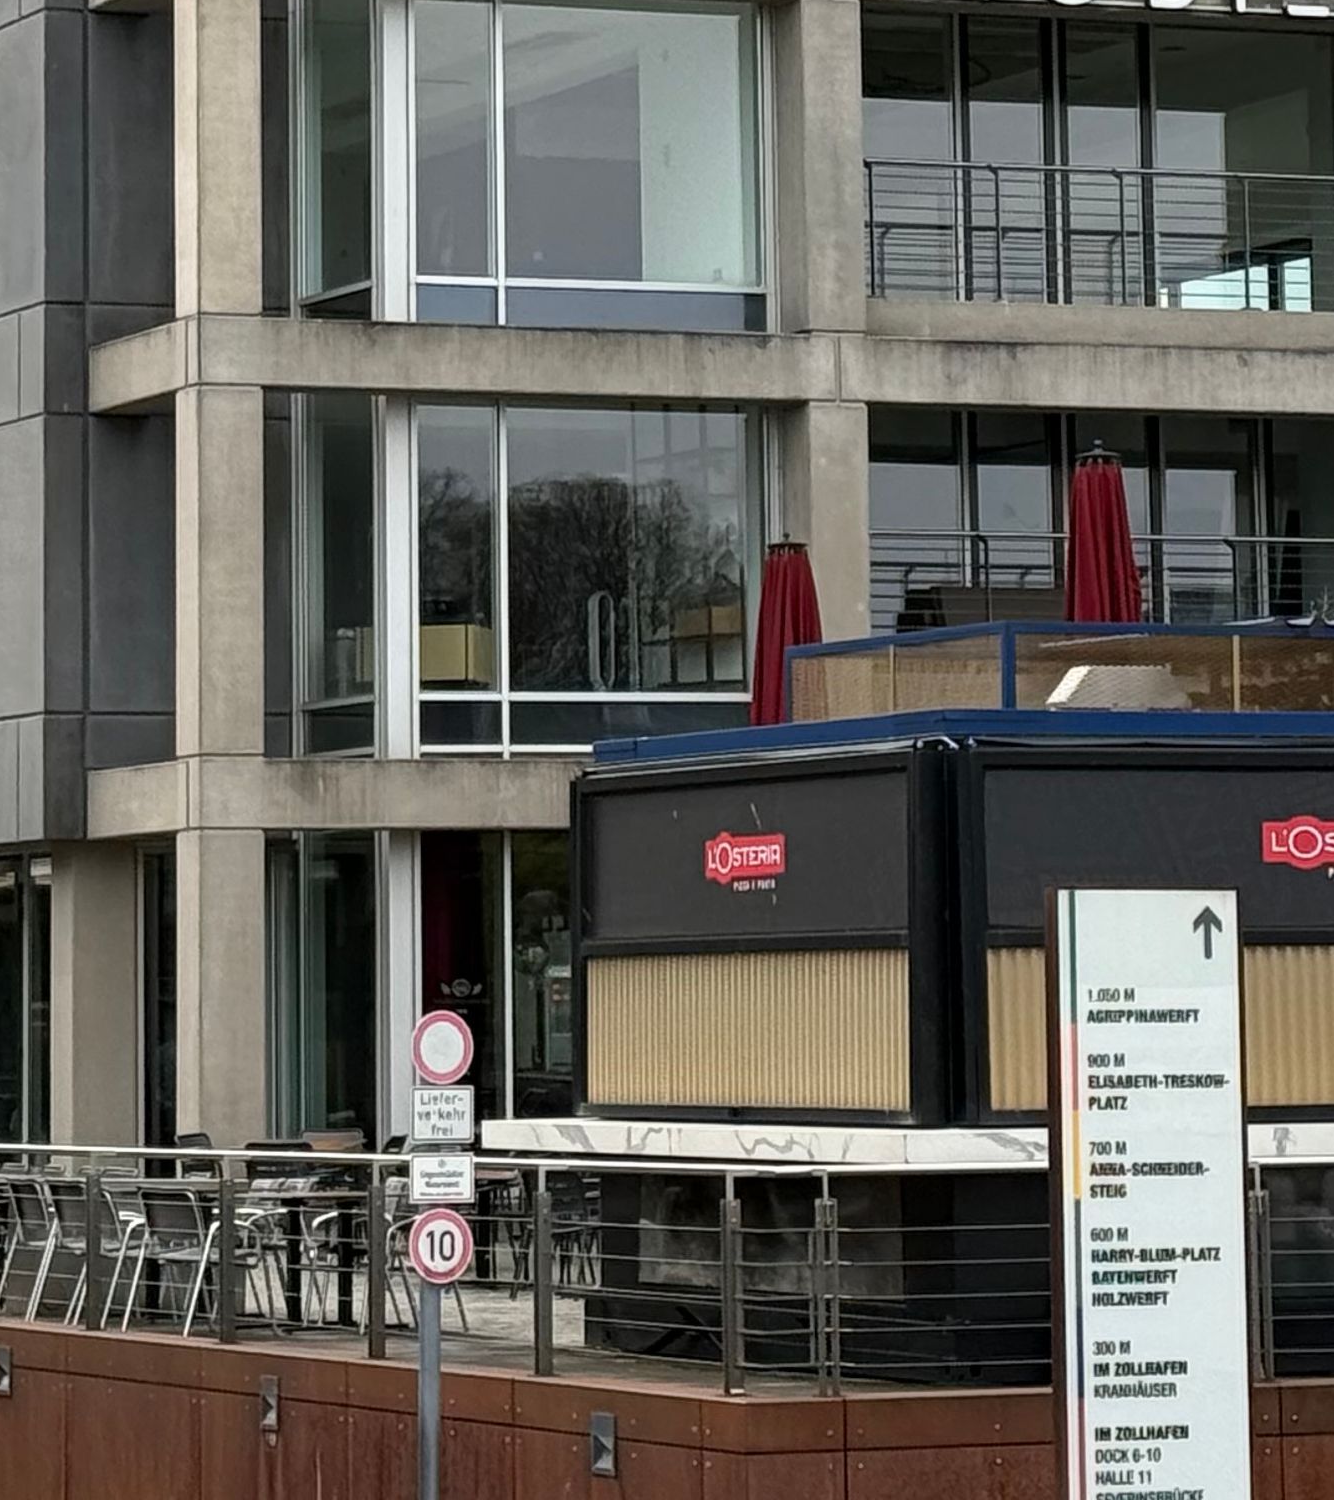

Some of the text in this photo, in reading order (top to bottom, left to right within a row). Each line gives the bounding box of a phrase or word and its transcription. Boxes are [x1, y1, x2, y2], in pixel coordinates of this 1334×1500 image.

[1124, 988, 1135, 1002] M
[1087, 1009, 1199, 1024] AGRIPPINAWERFT
[1088, 1054, 1125, 1068] 900 M
[1088, 1074, 1230, 1089] ELISABETH-TRESKOW-
[1089, 1096, 1128, 1111] PLATZ
[431, 1123, 454, 1137] frei
[1089, 1141, 1127, 1156] 700 M
[1090, 1184, 1127, 1199] STEIG
[1091, 1228, 1129, 1242] 600 M
[425, 1230, 455, 1263] 10
[1091, 1247, 1221, 1264] HARRY-BLUM-PLATZ
[1092, 1269, 1177, 1285] BAYENWERFT
[1092, 1291, 1169, 1307] HOLZWERFT
[1093, 1341, 1131, 1355] 300 M
[1094, 1360, 1188, 1376] IM ZOLLHAFEN
[1095, 1425, 1189, 1441] IM ZOLLHAFEN
[1095, 1447, 1161, 1464] DOCK 6-10
[1095, 1469, 1152, 1485] HALLE 11
